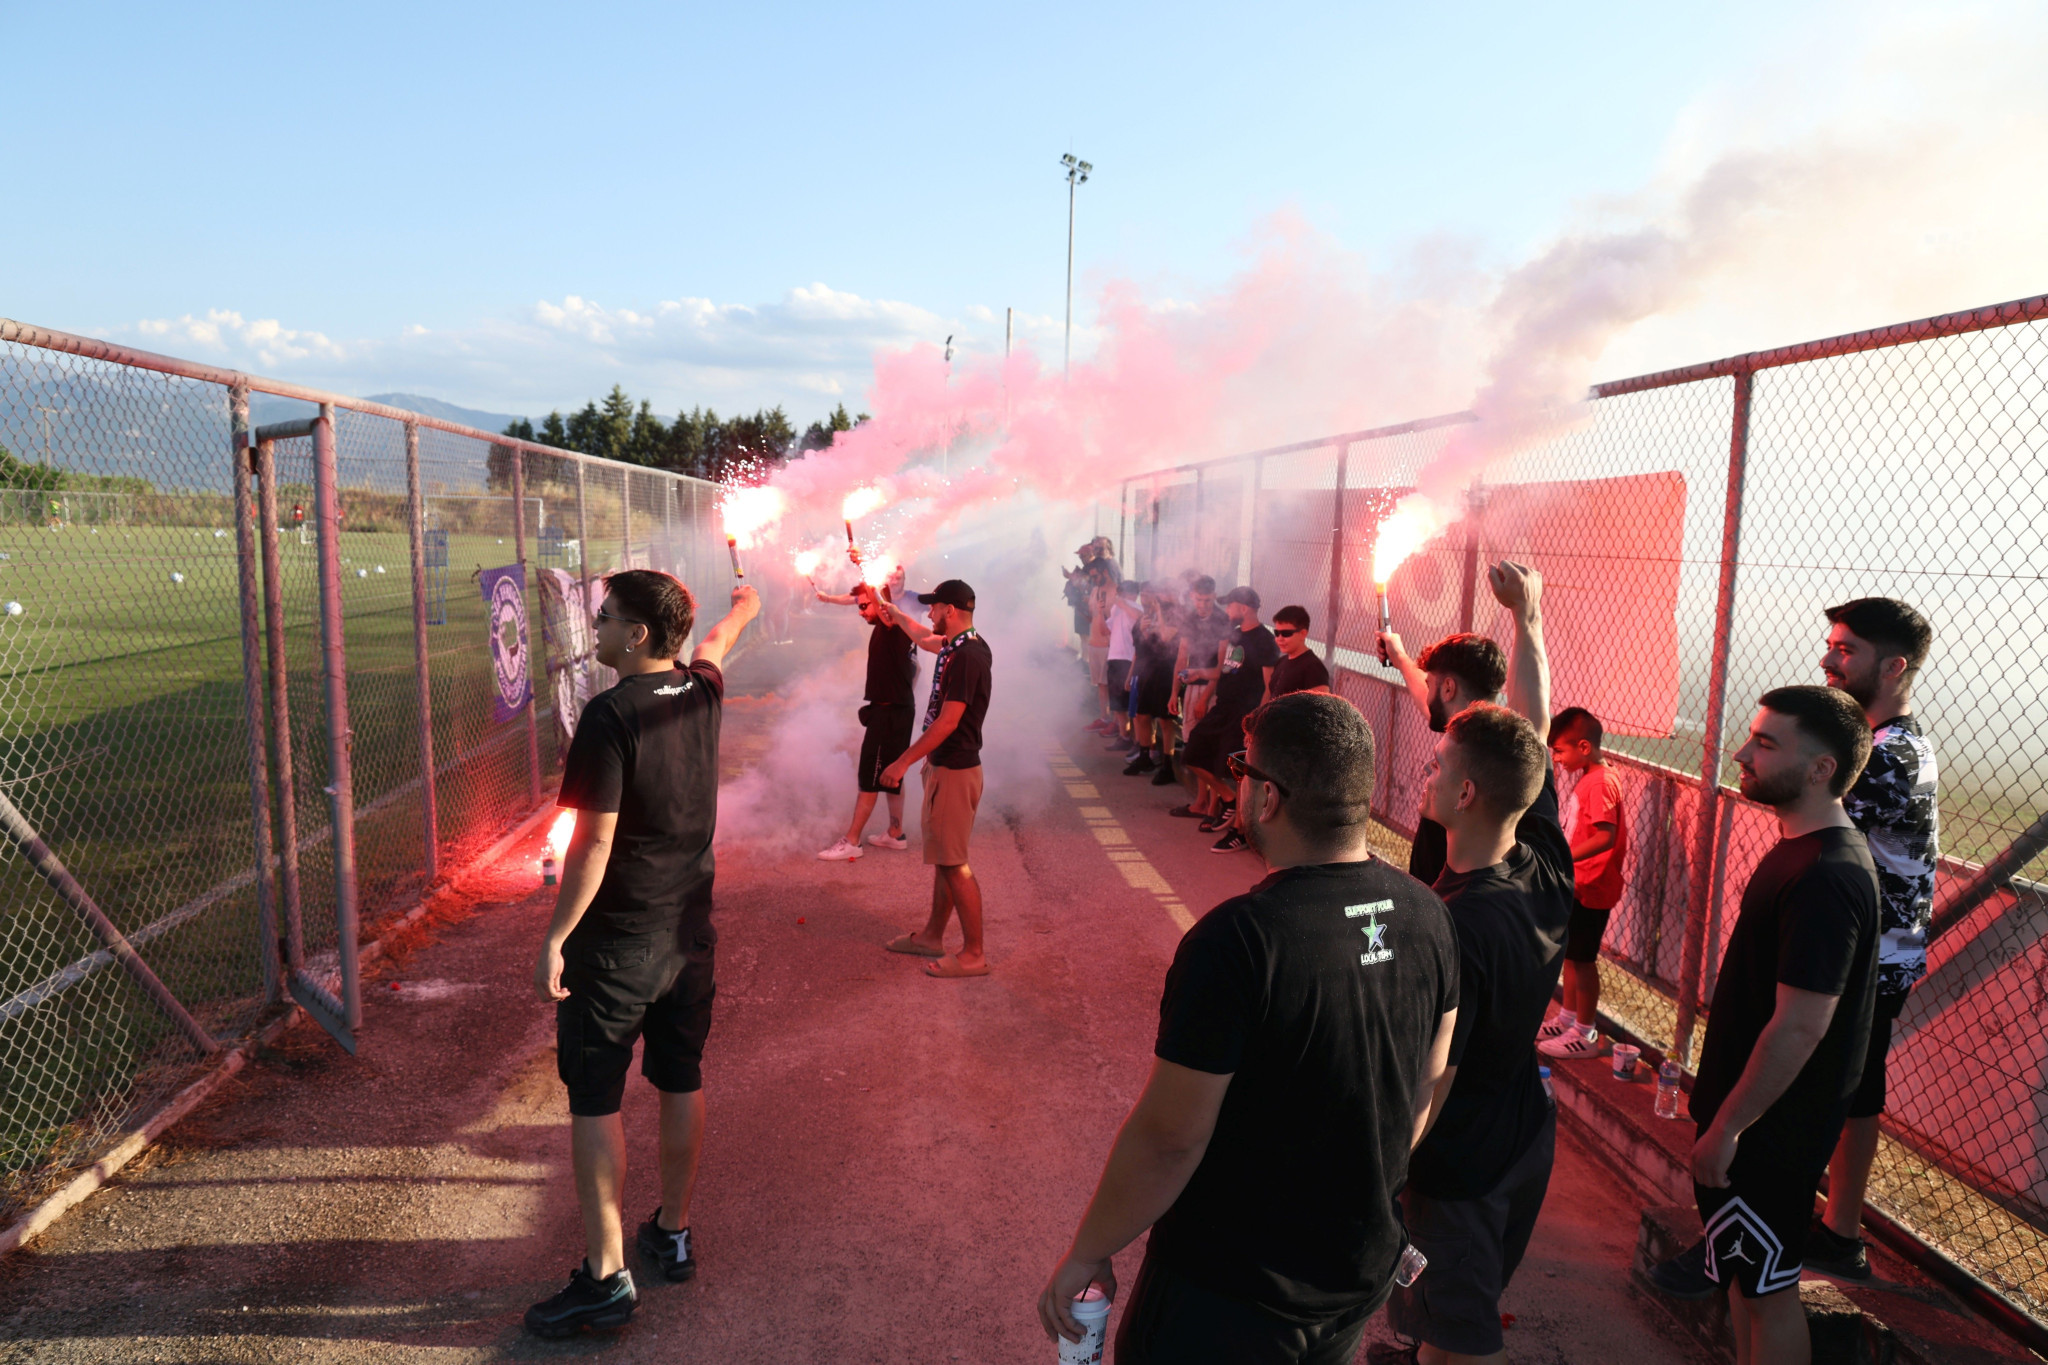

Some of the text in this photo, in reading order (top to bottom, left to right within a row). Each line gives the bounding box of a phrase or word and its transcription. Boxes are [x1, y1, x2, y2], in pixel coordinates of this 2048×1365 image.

[1344, 898, 1395, 918] SUPPORT YOUR
[1360, 948, 1395, 966] LOCAL TEAM
